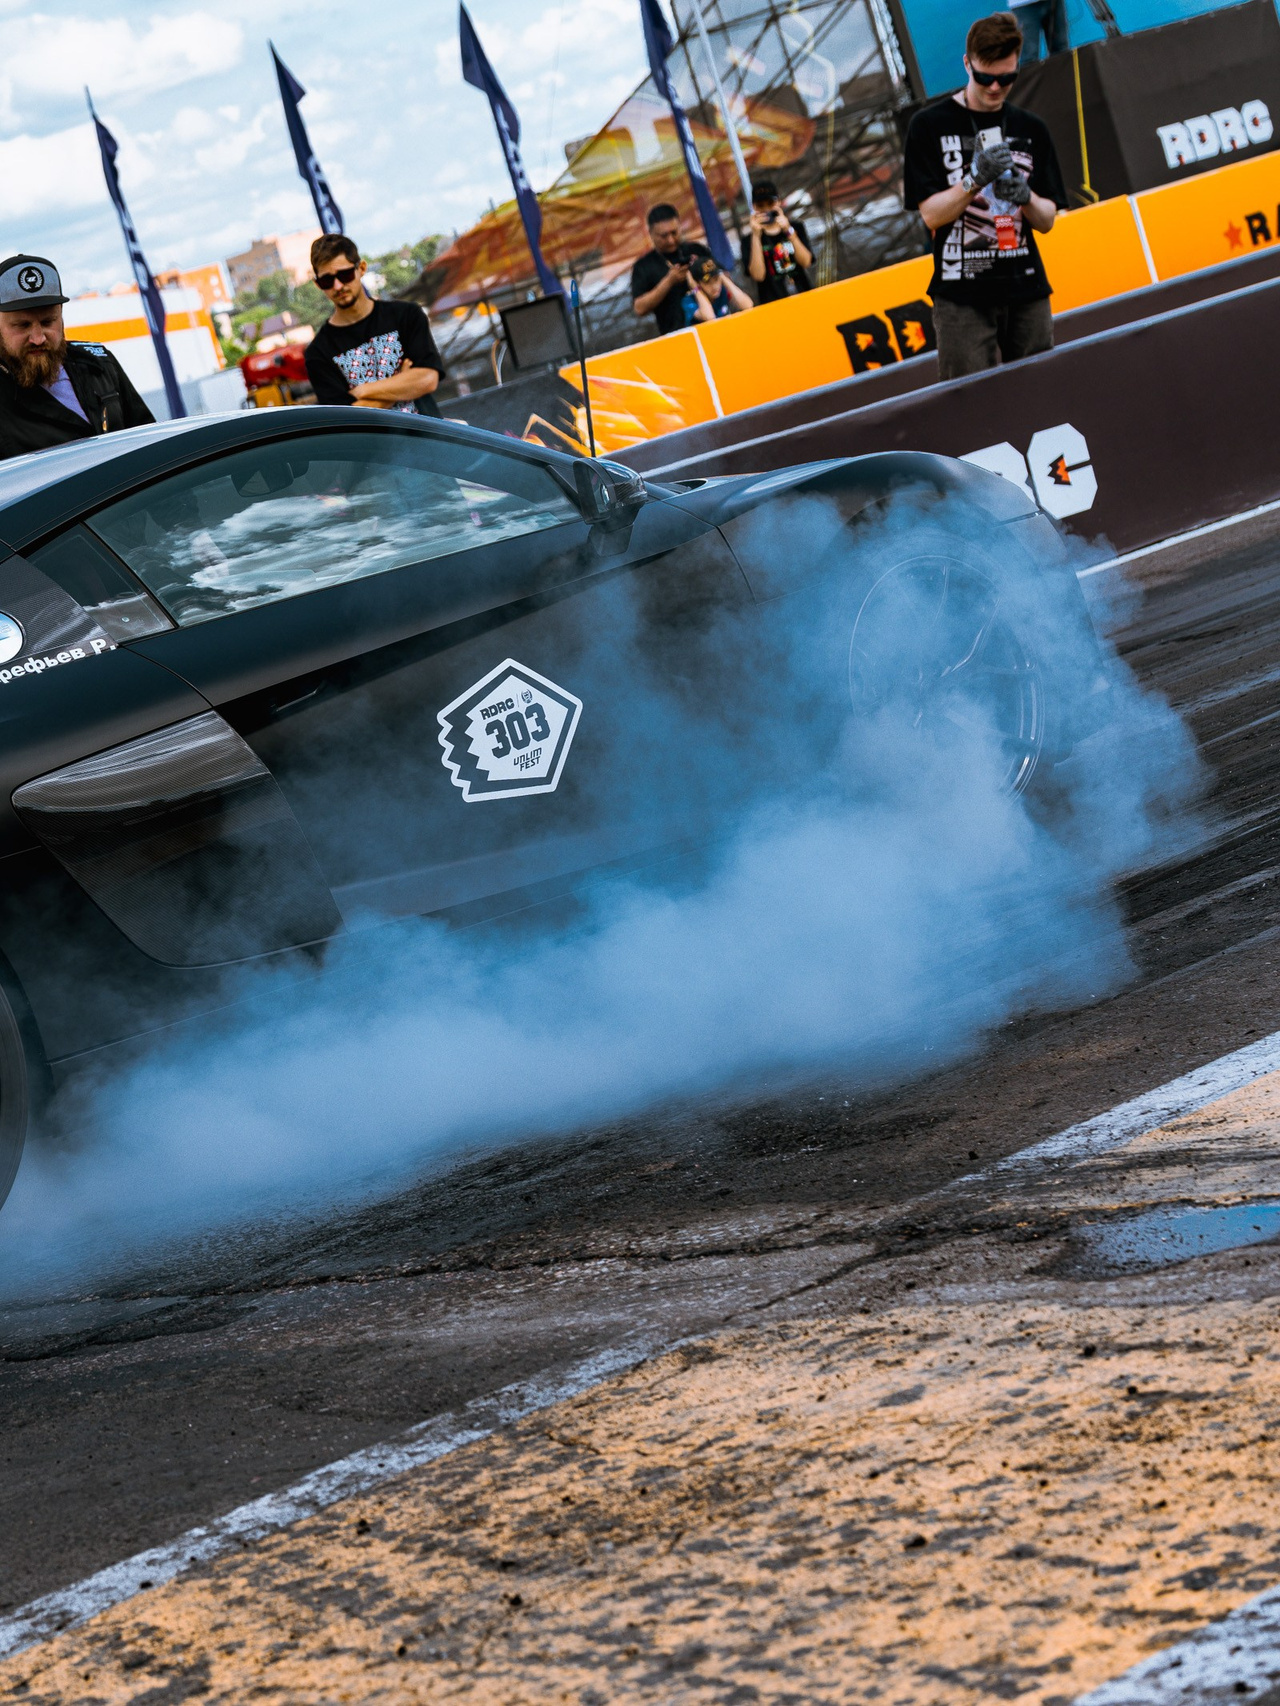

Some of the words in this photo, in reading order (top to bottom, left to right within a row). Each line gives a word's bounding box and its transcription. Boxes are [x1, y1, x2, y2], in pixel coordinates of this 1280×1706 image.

[1156, 99, 1274, 170] RDRC
[940, 134, 964, 186] ACE
[1244, 203, 1280, 246] R
[941, 219, 963, 281] KEE
[89, 638, 117, 655] Р.
[480, 697, 515, 720] RDRC
[485, 702, 551, 759] 303
[519, 756, 541, 772] FEST
